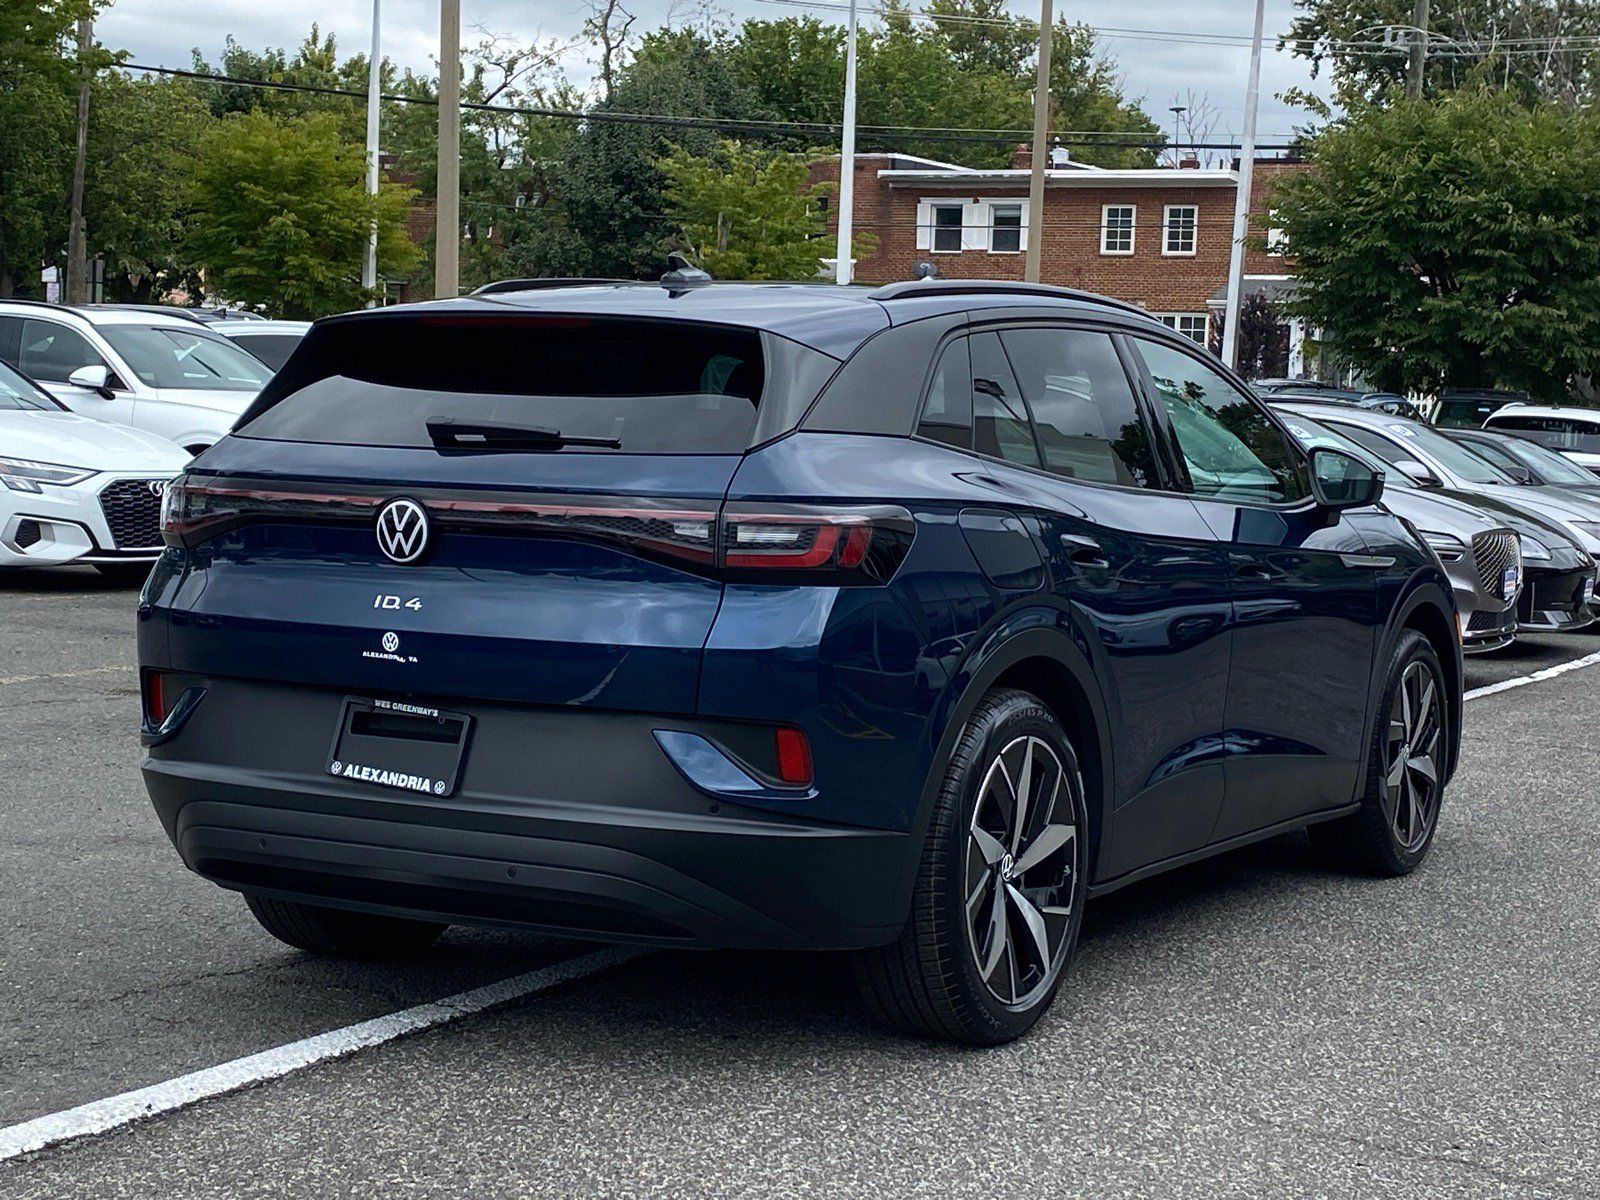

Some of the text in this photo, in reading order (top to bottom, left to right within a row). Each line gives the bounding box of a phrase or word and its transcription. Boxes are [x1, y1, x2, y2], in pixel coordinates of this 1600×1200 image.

[374, 699, 439, 717] WES GREENWAY'S
[343, 763, 431, 792] ALEXANDRIA
